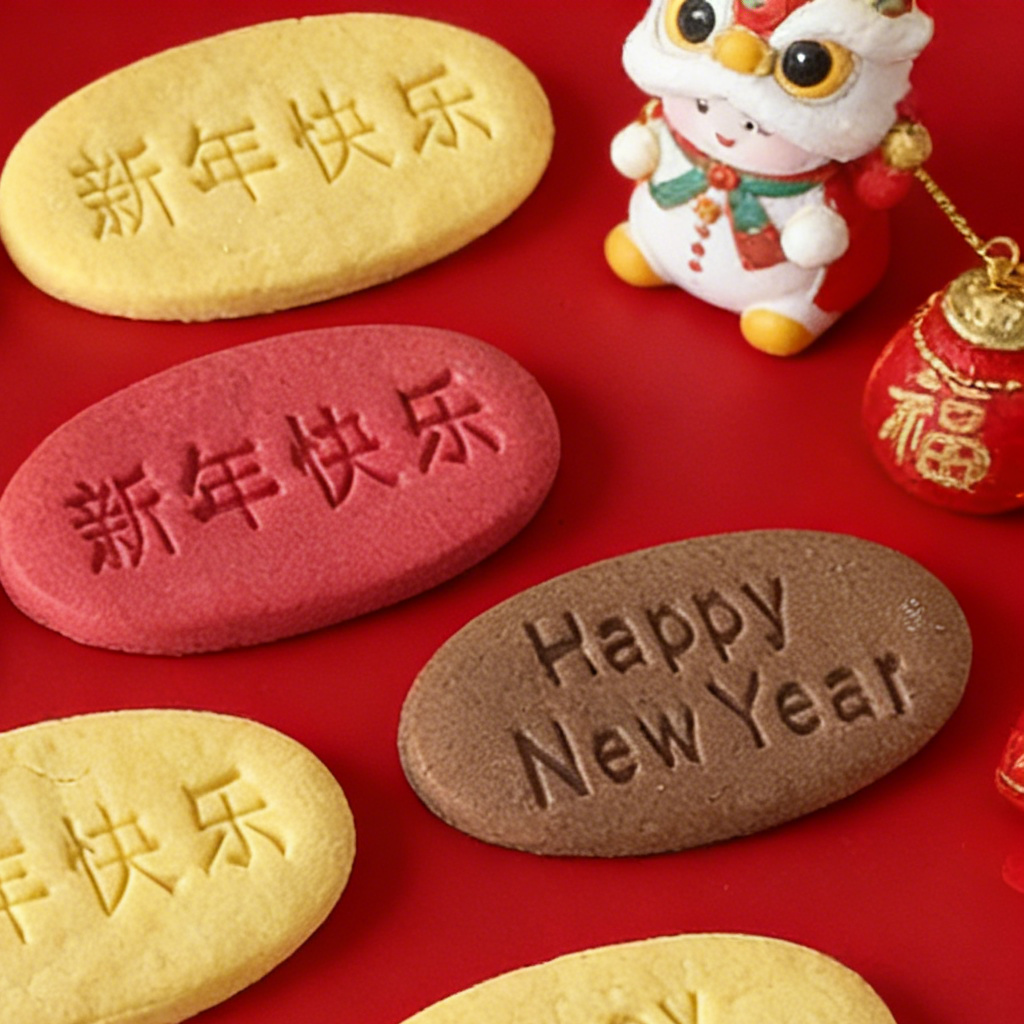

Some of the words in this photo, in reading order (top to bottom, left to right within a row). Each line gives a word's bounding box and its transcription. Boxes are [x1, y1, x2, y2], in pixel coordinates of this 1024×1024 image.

[67, 63, 493, 241] 新年快乐
[67, 369, 503, 575] 新年快乐
[879, 368, 992, 493] 福
[524, 577, 788, 687] Happy
[514, 706, 702, 809] New
[707, 652, 911, 749] Year
